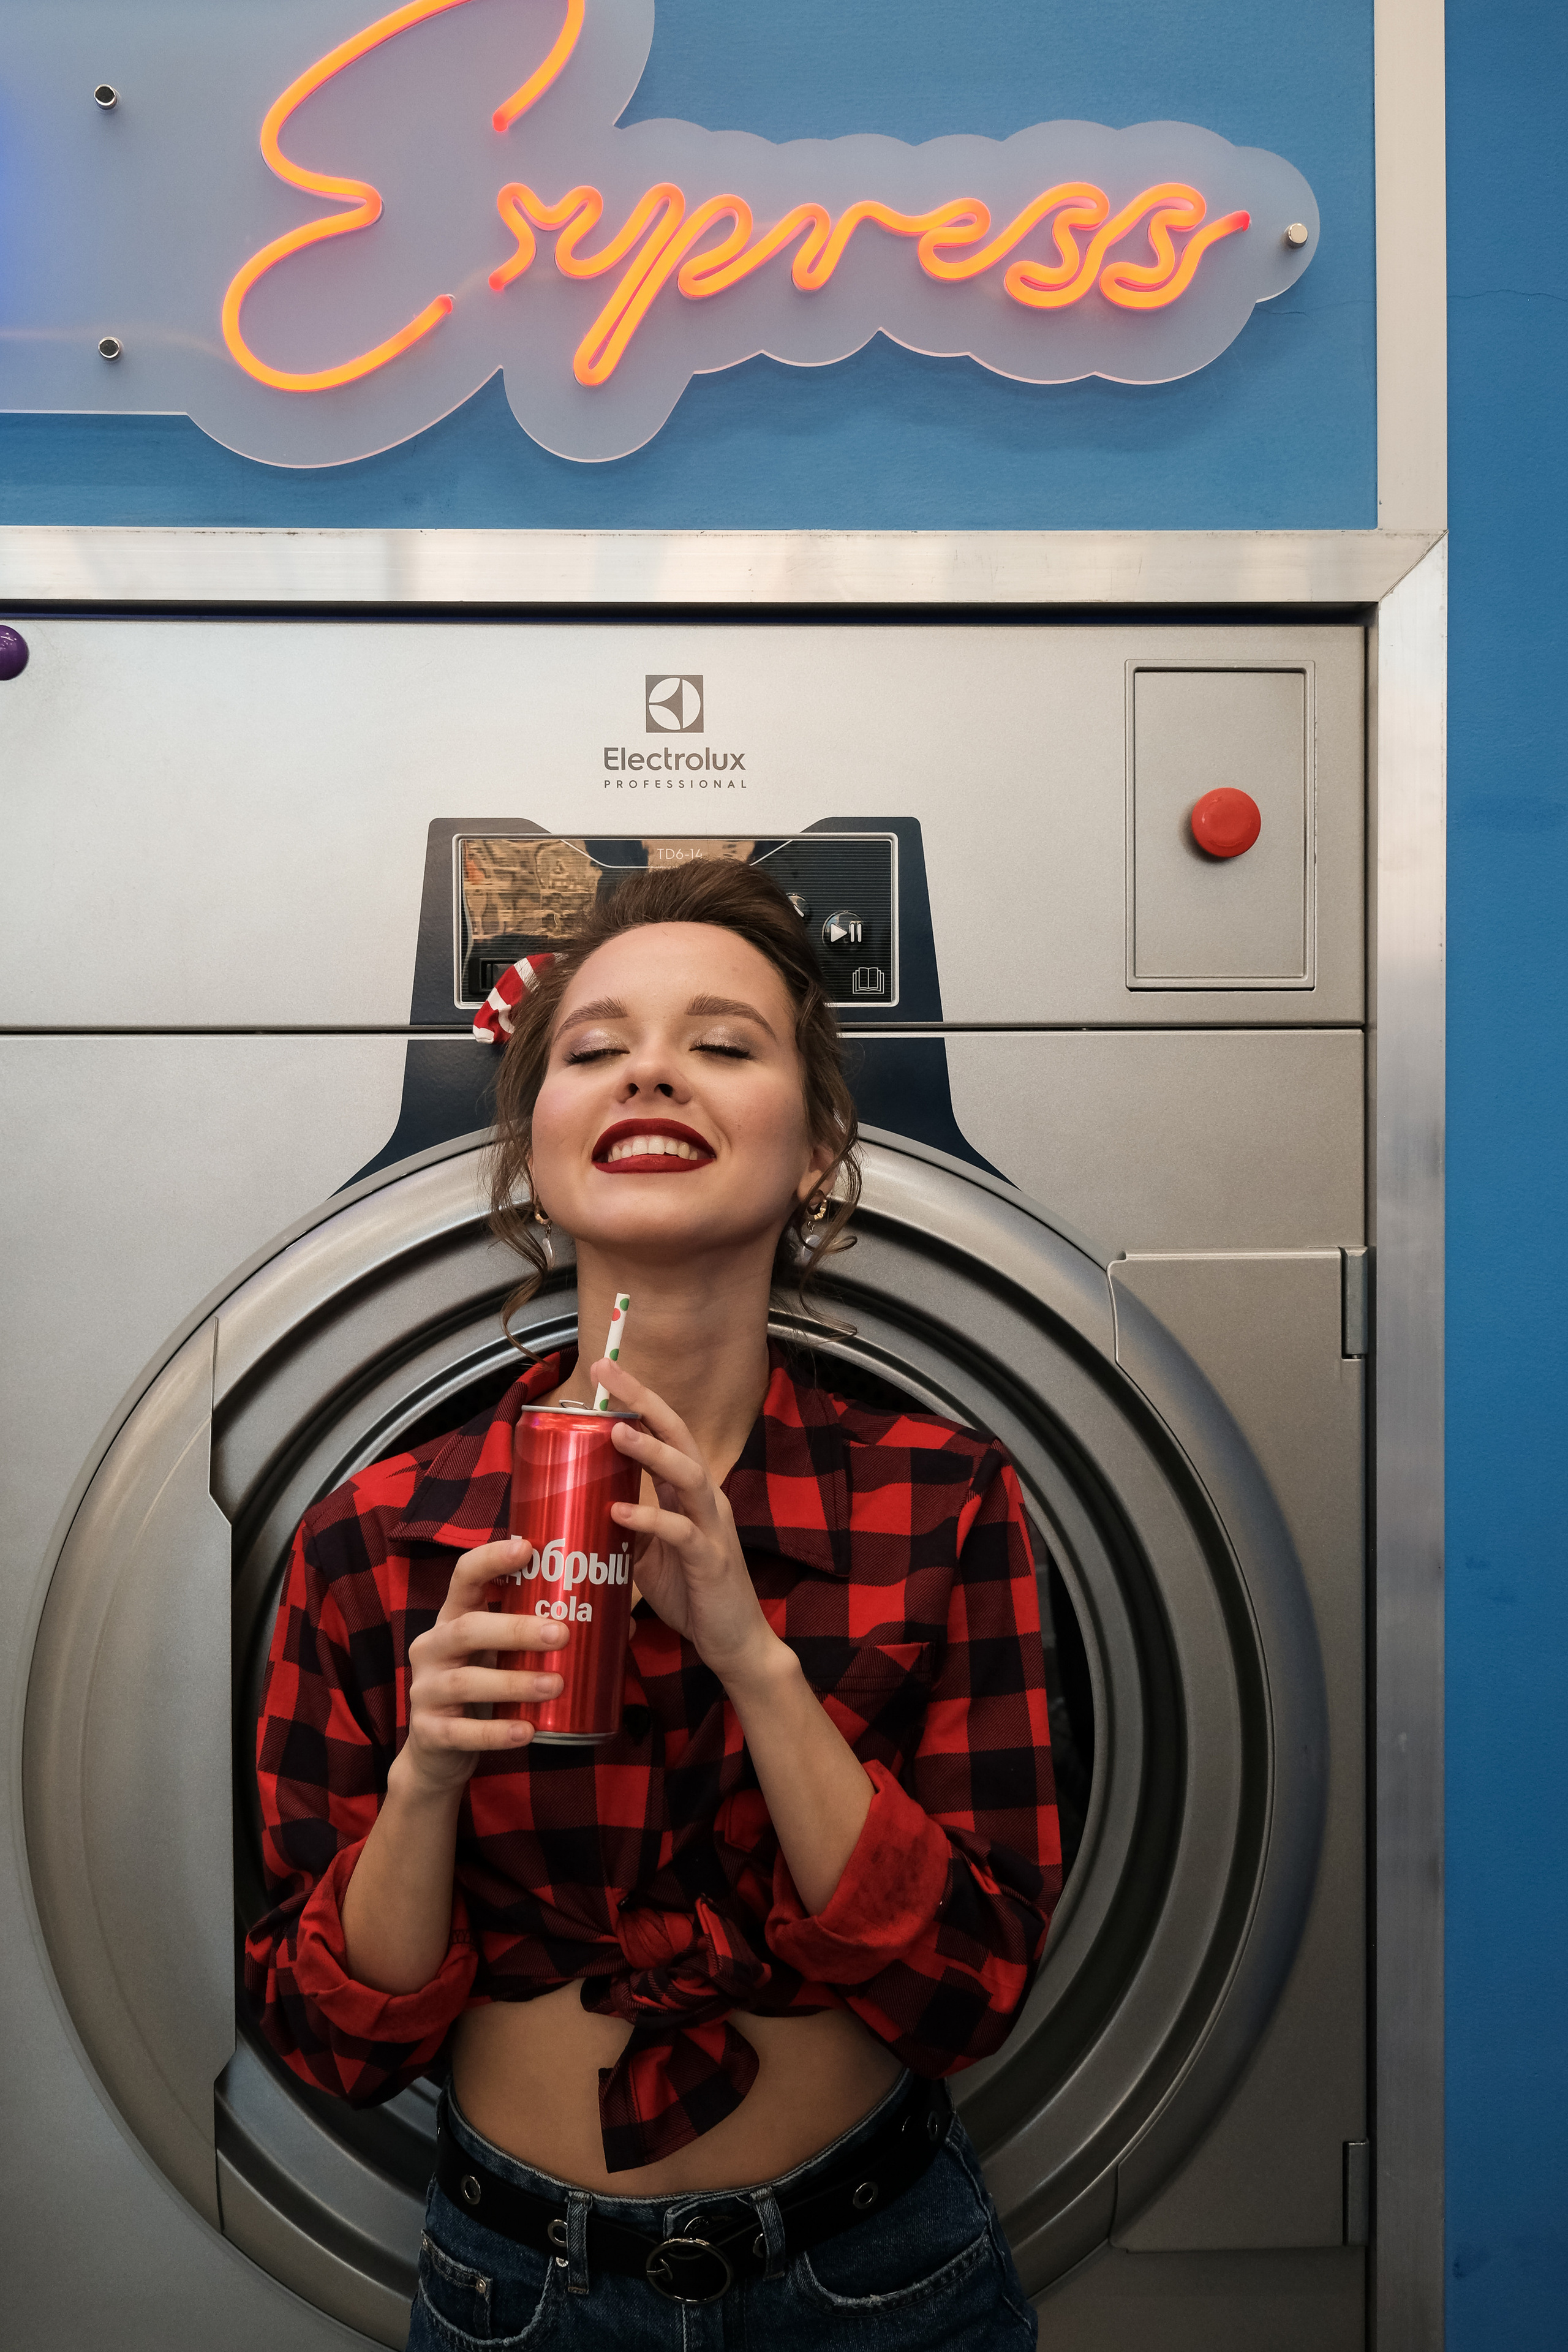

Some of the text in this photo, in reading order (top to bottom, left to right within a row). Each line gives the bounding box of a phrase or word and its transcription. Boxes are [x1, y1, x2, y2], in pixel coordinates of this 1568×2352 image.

[221, 0, 1251, 391] Express
[604, 747, 746, 771] Electrolux
[604, 780, 747, 788] PROFESSIONAL
[657, 848, 703, 860] TD6-14
[535, 1596, 592, 1622] cola
